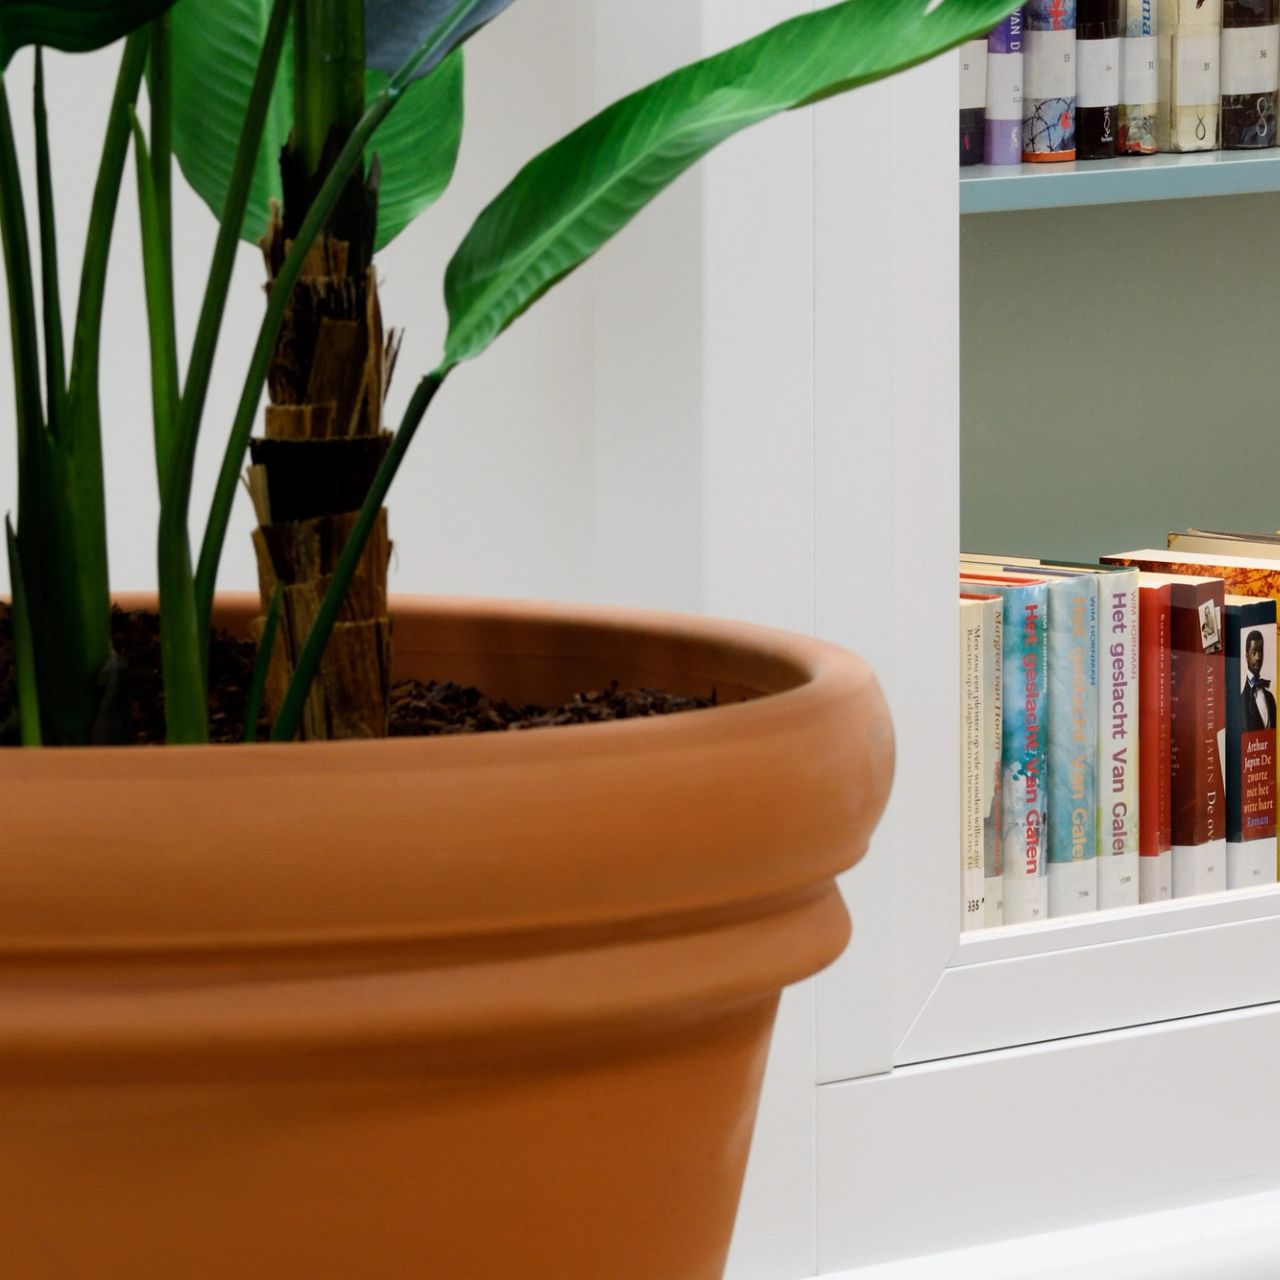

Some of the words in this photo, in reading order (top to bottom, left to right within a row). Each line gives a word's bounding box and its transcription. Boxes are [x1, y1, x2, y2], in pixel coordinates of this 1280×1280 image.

[1024, 603, 1038, 645] Het
[1111, 592, 1128, 634] Het
[1021, 652, 1039, 749] geslacht
[1109, 642, 1129, 740] geslacht
[1243, 756, 1260, 773] Japin
[1261, 755, 1272, 766] De
[1247, 738, 1268, 753] Arthur
[1024, 759, 1039, 804] Van
[1111, 747, 1127, 793] Van
[1246, 787, 1257, 798] met
[1258, 783, 1269, 796] het
[1247, 771, 1268, 783] zwarte
[1243, 800, 1257, 814] witte
[1258, 798, 1273, 811] hart
[1024, 809, 1039, 875] Galen
